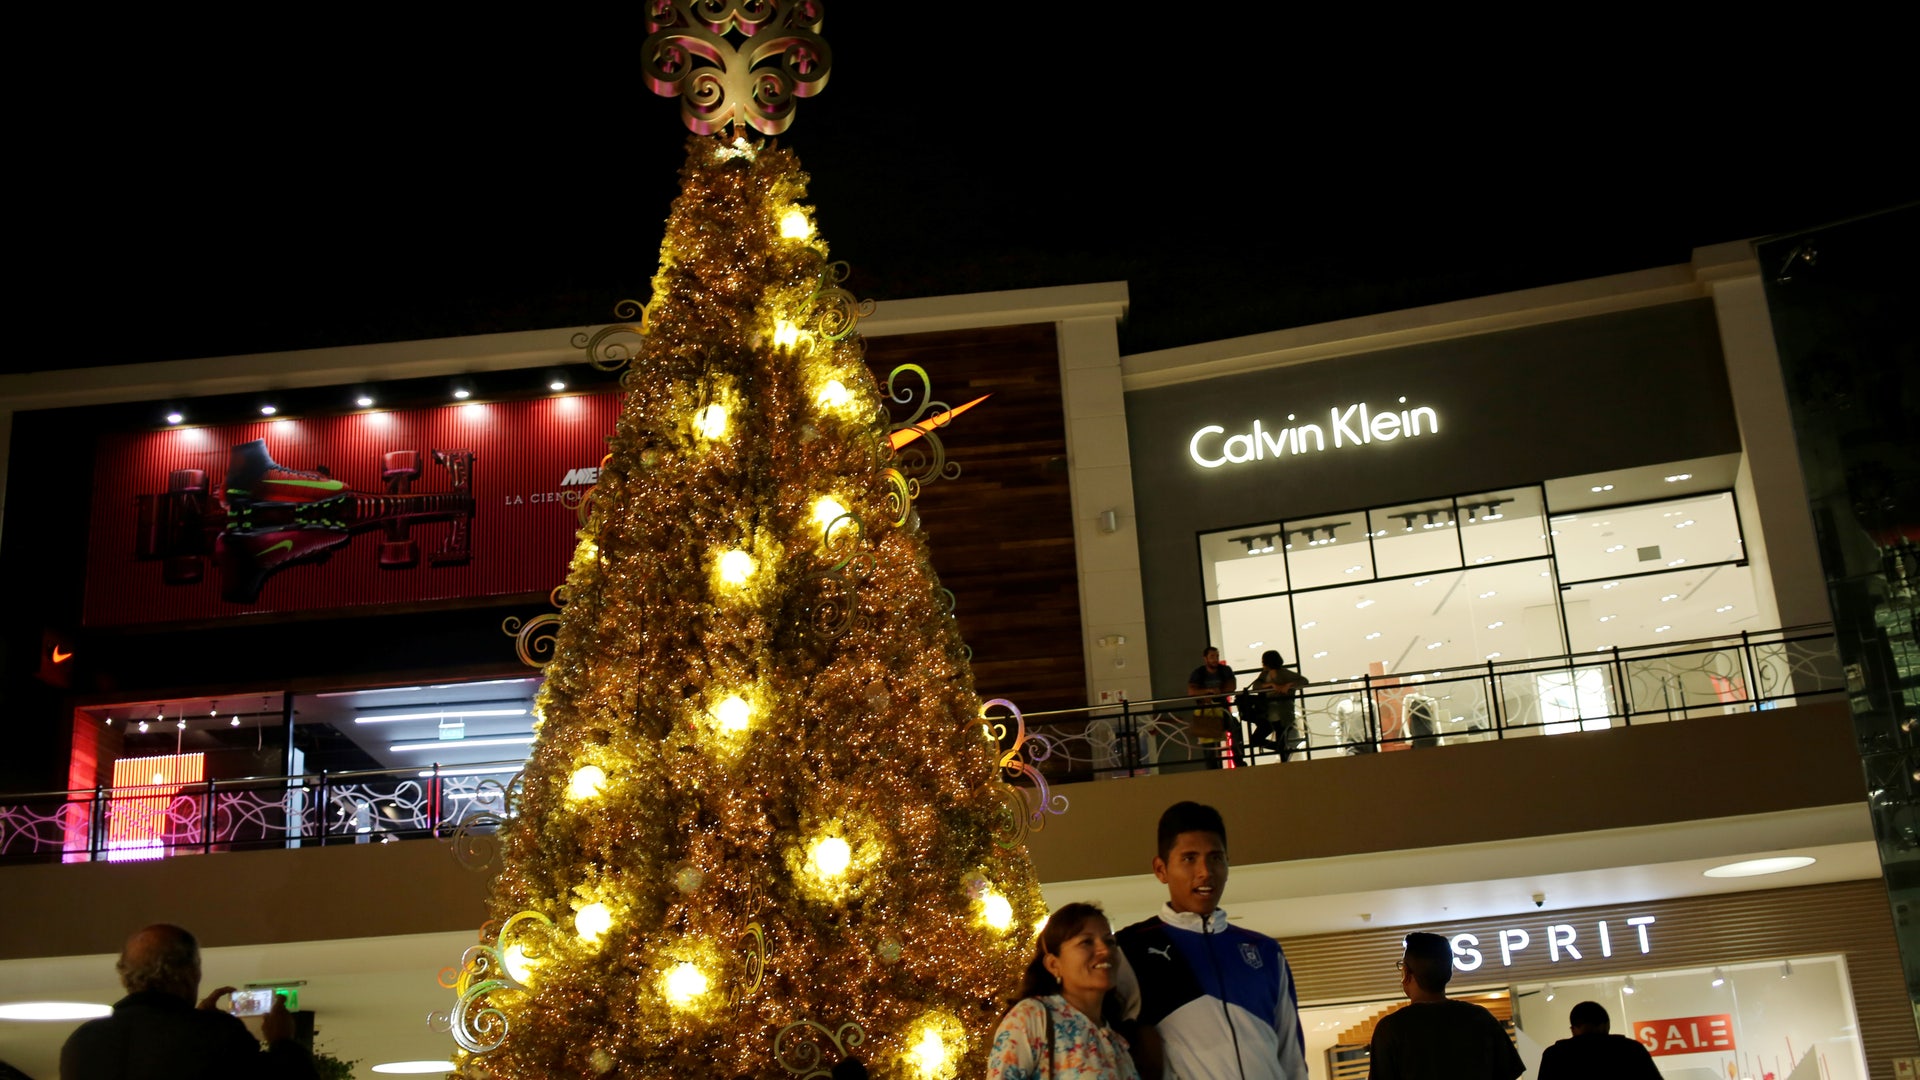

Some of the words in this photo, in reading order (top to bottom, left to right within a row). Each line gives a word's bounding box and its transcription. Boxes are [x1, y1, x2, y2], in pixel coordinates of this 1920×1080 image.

[1189, 413, 1325, 469] Calvin
[1331, 395, 1438, 449] Klein
[505, 494, 524, 506] LA
[1403, 915, 1656, 972] SPRIT
[1639, 1020, 1729, 1052] SALE
